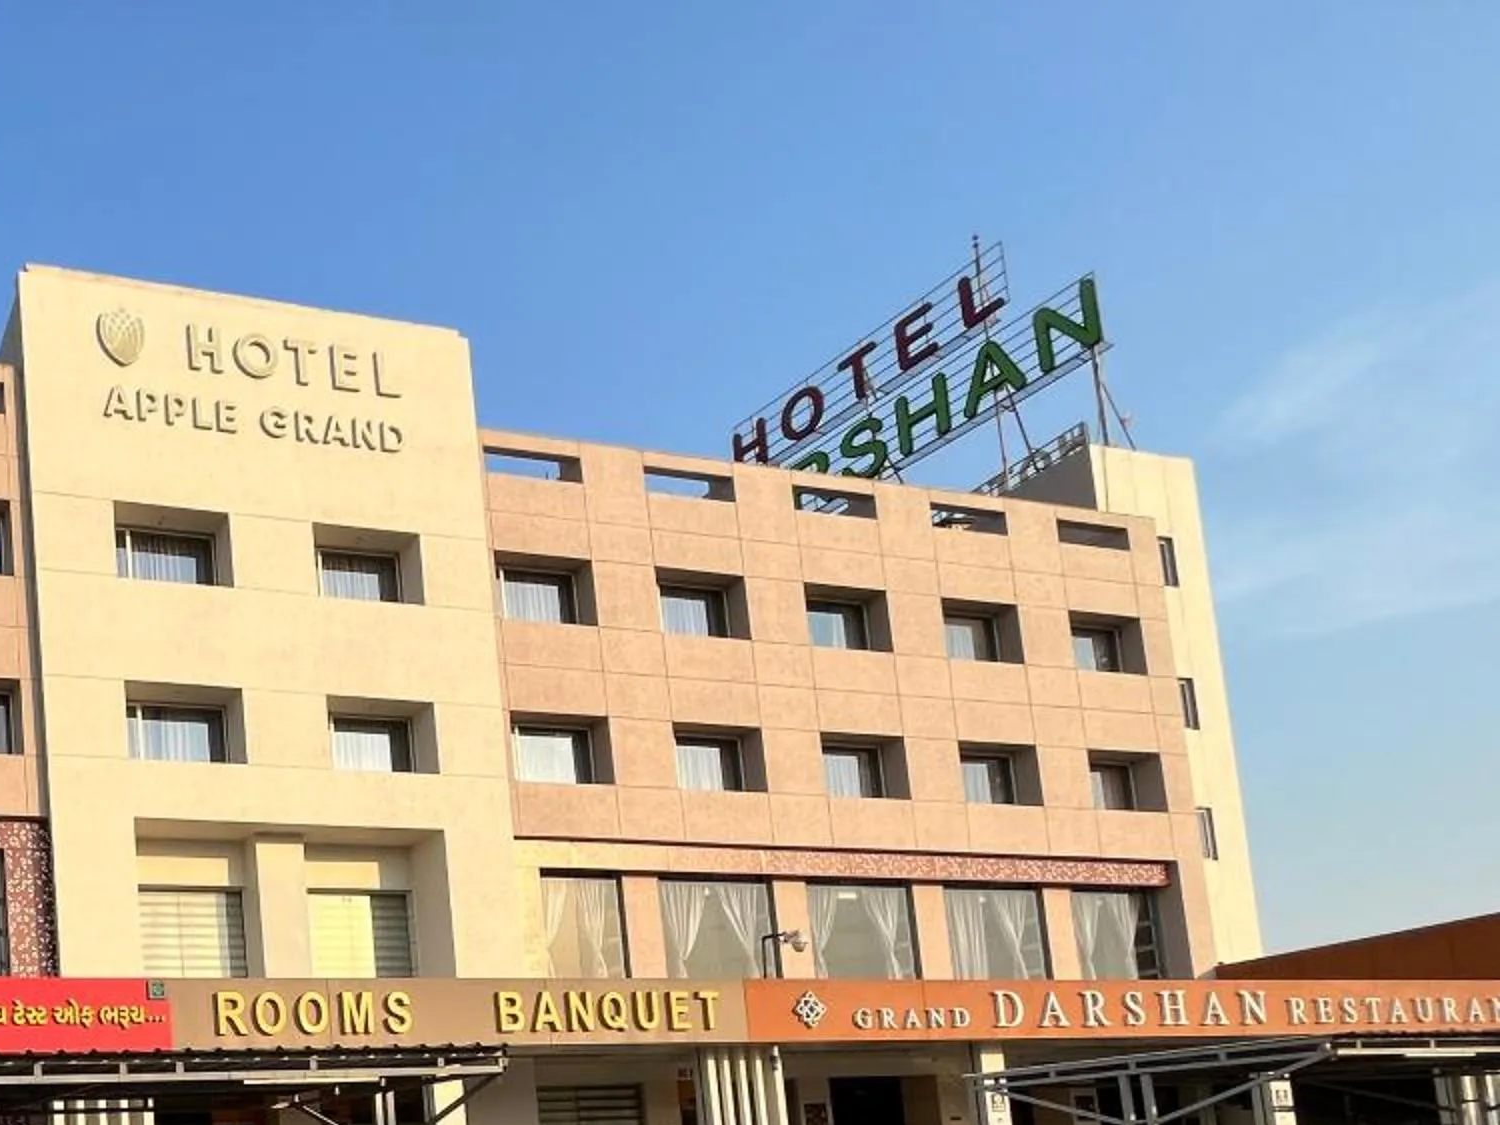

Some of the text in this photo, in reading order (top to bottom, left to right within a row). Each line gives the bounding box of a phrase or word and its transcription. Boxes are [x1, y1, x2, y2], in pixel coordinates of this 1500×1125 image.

[186, 323, 401, 398] HOTEL
[732, 275, 1005, 464] HOTEL
[103, 384, 403, 453] APPLE GRAND
[214, 990, 413, 1036] ROOMS
[495, 989, 720, 1034] BANQUET
[852, 1006, 971, 1030] GRAND
[990, 989, 1268, 1029] DARSHAN
